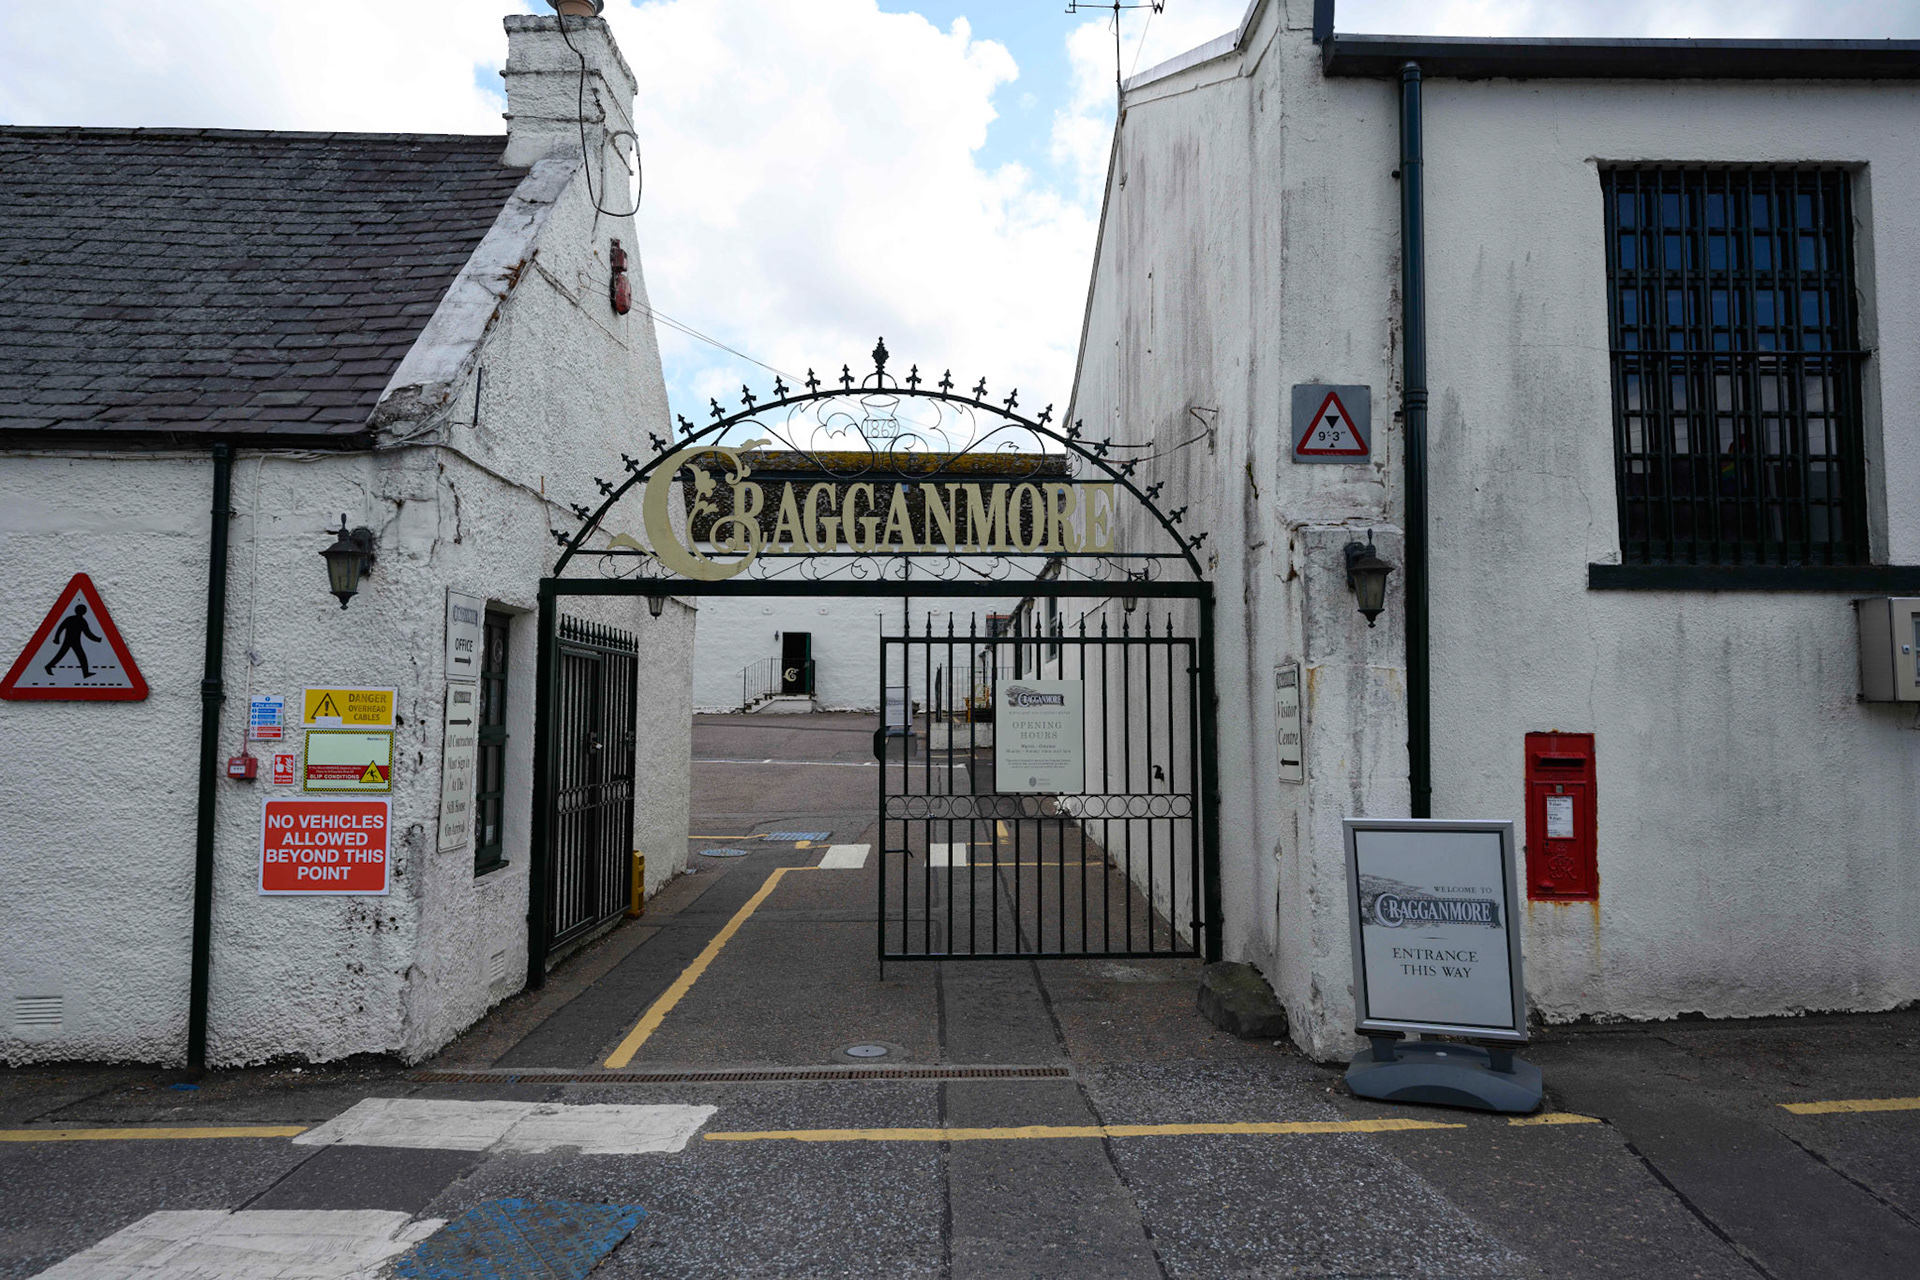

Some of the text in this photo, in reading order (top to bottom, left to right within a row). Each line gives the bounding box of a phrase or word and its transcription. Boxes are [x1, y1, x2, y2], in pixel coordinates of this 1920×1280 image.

[866, 419, 897, 438] 1869
[611, 438, 1115, 581] CRAGGANMORE
[455, 638, 473, 652] OFFICE
[348, 693, 387, 703] DANGER
[1017, 692, 1062, 707] CRAGGANMORE
[348, 704, 386, 713] OVERHEAD
[1277, 701, 1297, 718] Visitor
[353, 713, 380, 721] CABLES
[1012, 721, 1062, 730] OPENING
[1020, 731, 1058, 740] HOURS
[1278, 727, 1298, 745] Centre
[268, 815, 384, 829] NO VEHICLES
[281, 832, 369, 846] ALLOWED
[265, 849, 384, 863] BEYOND THIS
[297, 866, 352, 880] POINT
[1433, 885, 1492, 894] WELCOME TO
[1374, 893, 1492, 928] CRAGGANMORE
[1393, 947, 1479, 963] ENTRANCE
[1400, 964, 1472, 978] THIS WAY
